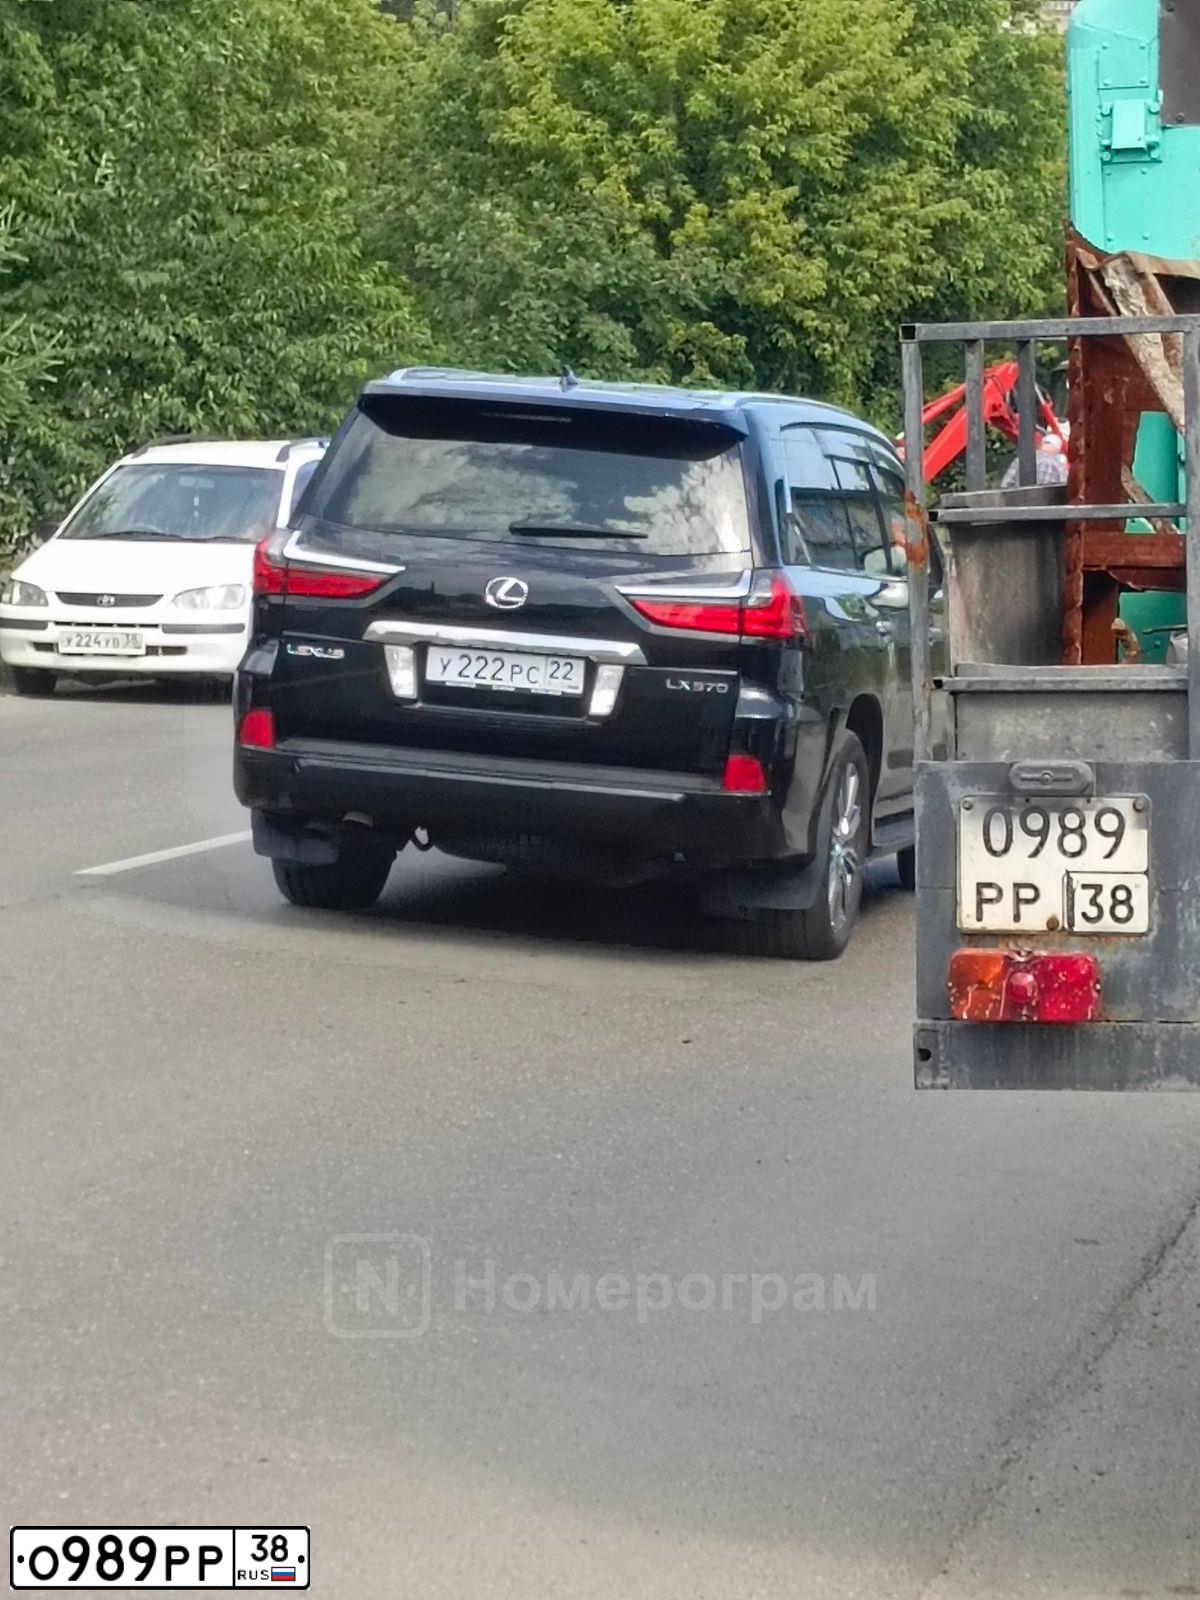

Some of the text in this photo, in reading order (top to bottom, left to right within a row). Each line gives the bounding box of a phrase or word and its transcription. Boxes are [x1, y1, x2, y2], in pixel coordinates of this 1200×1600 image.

[549, 660, 574, 681] 22
[982, 806, 1126, 859] 0989
[1081, 883, 1134, 924] 38
